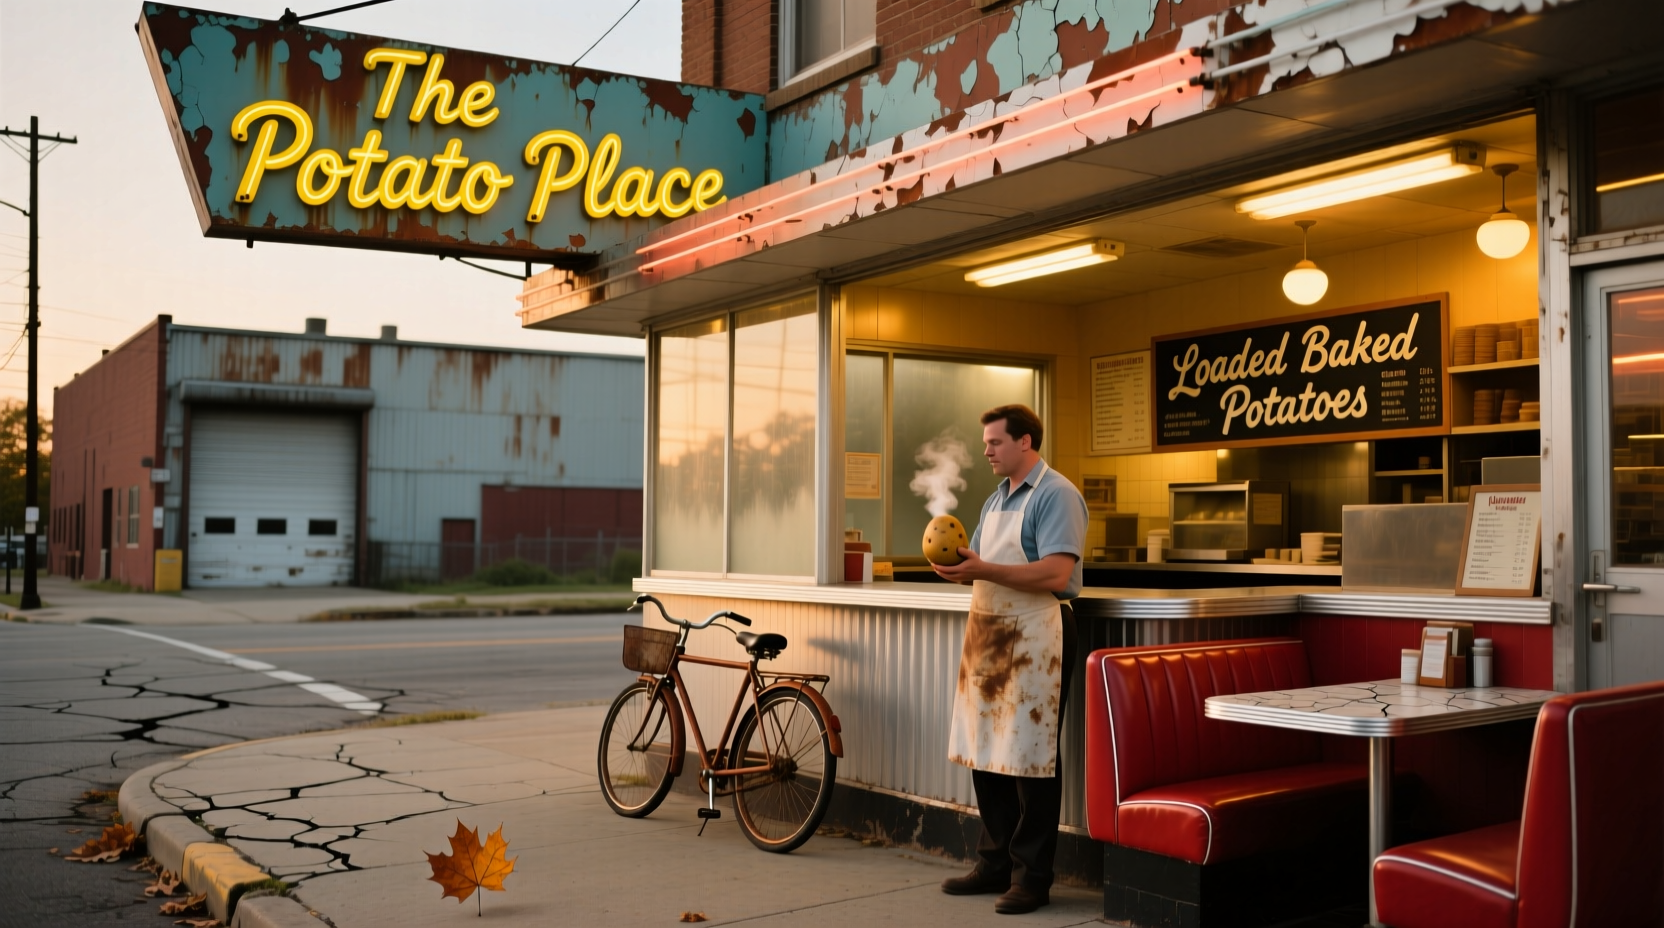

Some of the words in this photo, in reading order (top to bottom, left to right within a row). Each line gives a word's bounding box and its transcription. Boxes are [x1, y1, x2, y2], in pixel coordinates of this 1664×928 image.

[364, 47, 500, 128] The
[230, 100, 515, 215] Potato
[524, 129, 729, 223] Place
[1168, 331, 1290, 401] Loaded
[1300, 312, 1420, 374] Baked
[1219, 382, 1368, 436] Potatoes
